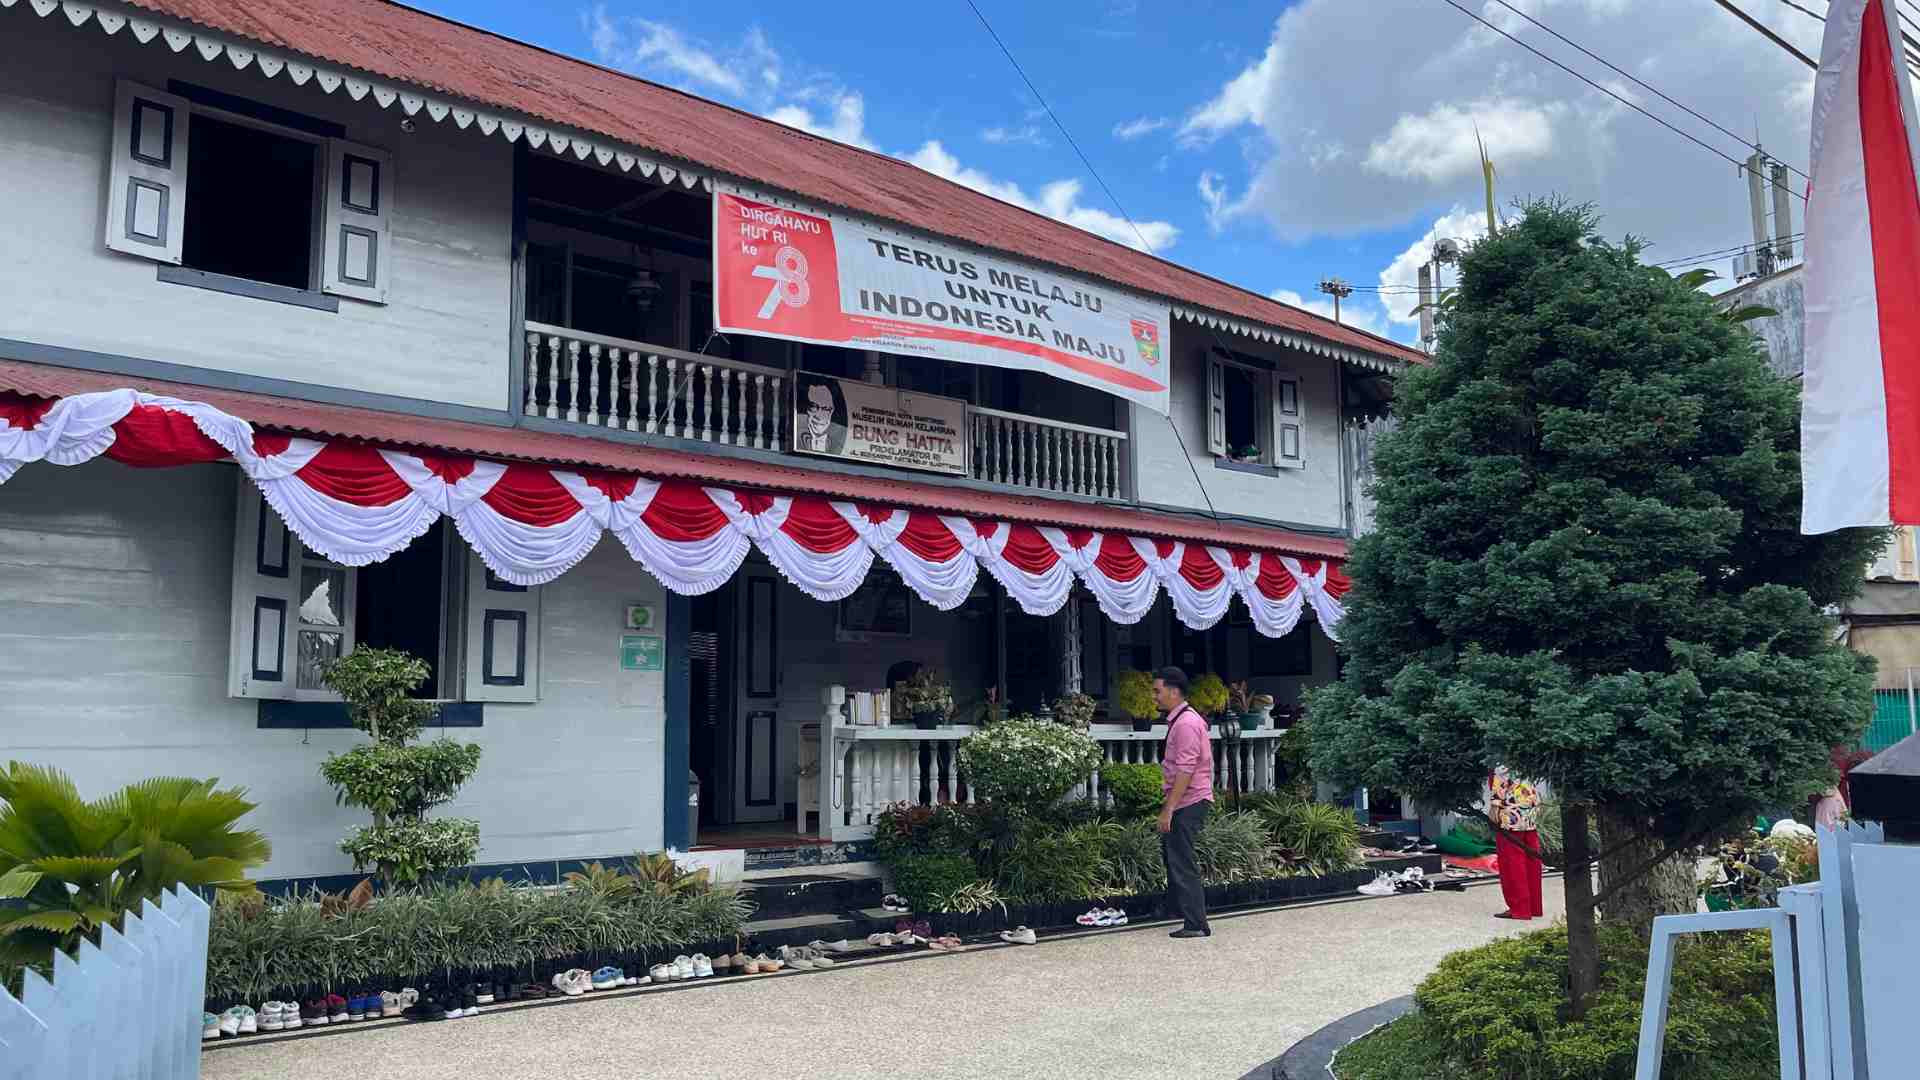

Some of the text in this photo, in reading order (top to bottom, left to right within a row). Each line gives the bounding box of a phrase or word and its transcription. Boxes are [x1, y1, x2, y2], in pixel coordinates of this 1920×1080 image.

[741, 207, 821, 234] DIRGAHAYU
[741, 223, 788, 244] HUT RI
[742, 241, 758, 256] ke
[752, 246, 810, 319] 78
[868, 238, 1102, 313] TERUS MELAJU
[944, 280, 1054, 321] UNTUK
[860, 289, 1126, 364] INDONESIA MAJU
[852, 412, 885, 426] MUSEUM
[886, 418, 913, 430] RUMAH
[853, 424, 954, 455] BUNG HATTA
